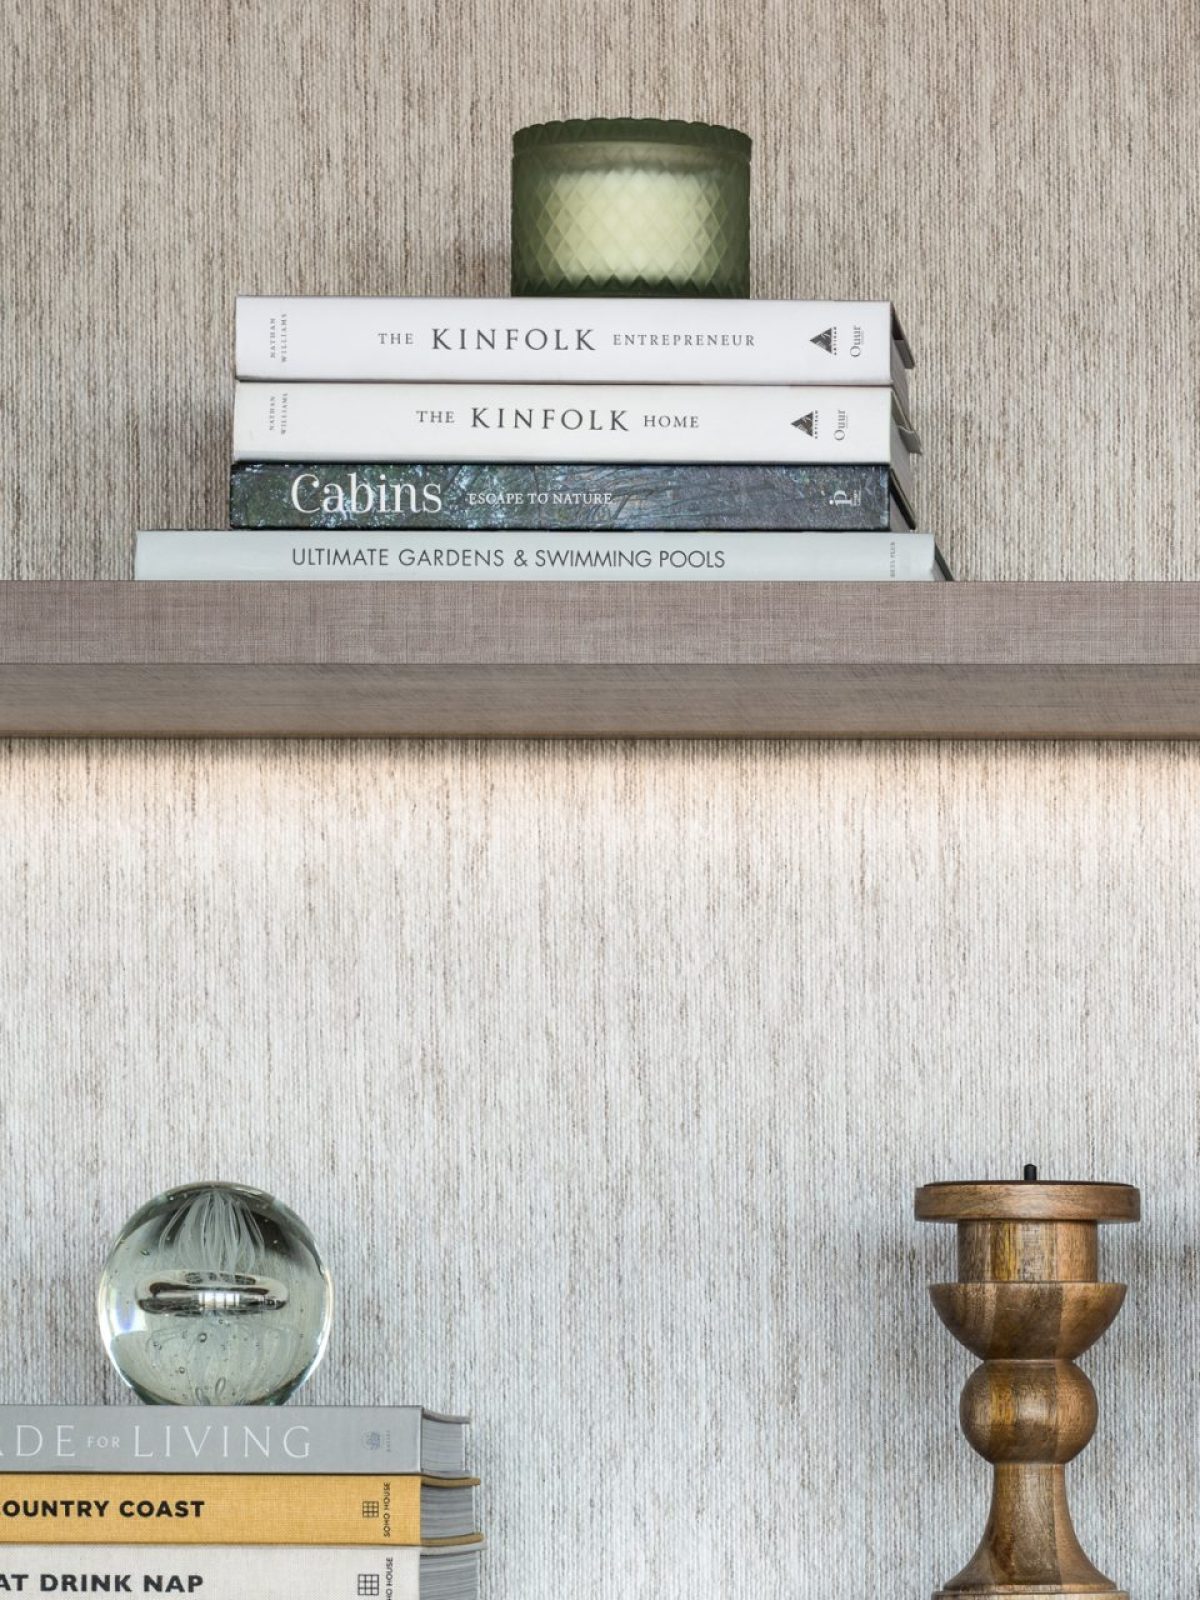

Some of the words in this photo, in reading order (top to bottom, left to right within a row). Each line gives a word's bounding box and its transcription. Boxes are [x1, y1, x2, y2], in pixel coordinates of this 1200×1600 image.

[280, 313, 288, 362] WILLIAMS
[378, 332, 414, 345] THE
[432, 328, 596, 351] KINFOLK
[613, 334, 755, 347] ENTREPRENEUR
[849, 325, 861, 358] Ouur
[416, 410, 455, 424] THE
[471, 407, 629, 432] KINFOLK
[644, 415, 699, 428] HOME
[833, 409, 846, 441] Ouur
[290, 473, 442, 514] Cabins
[469, 493, 524, 505] ESCAPE
[527, 493, 549, 505] TO
[553, 493, 612, 505] NATURE
[293, 547, 389, 566] ULTIMATE
[398, 548, 505, 567] GARDENS
[514, 549, 528, 567] &
[535, 549, 652, 568] SWIMMING
[659, 549, 726, 569] POOLS
[0, 1425, 76, 1457] DE
[87, 1436, 121, 1449] FOR
[134, 1425, 310, 1459] LIVING
[0, 1500, 110, 1518] OUNTRY
[119, 1500, 205, 1518] COAST
[383, 1482, 391, 1510] HOUSE
[383, 1513, 391, 1538] SOHO
[0, 1574, 29, 1592] AT
[40, 1574, 132, 1593] DRINK
[143, 1574, 204, 1593] NAP
[385, 1557, 394, 1586] HOUSE
